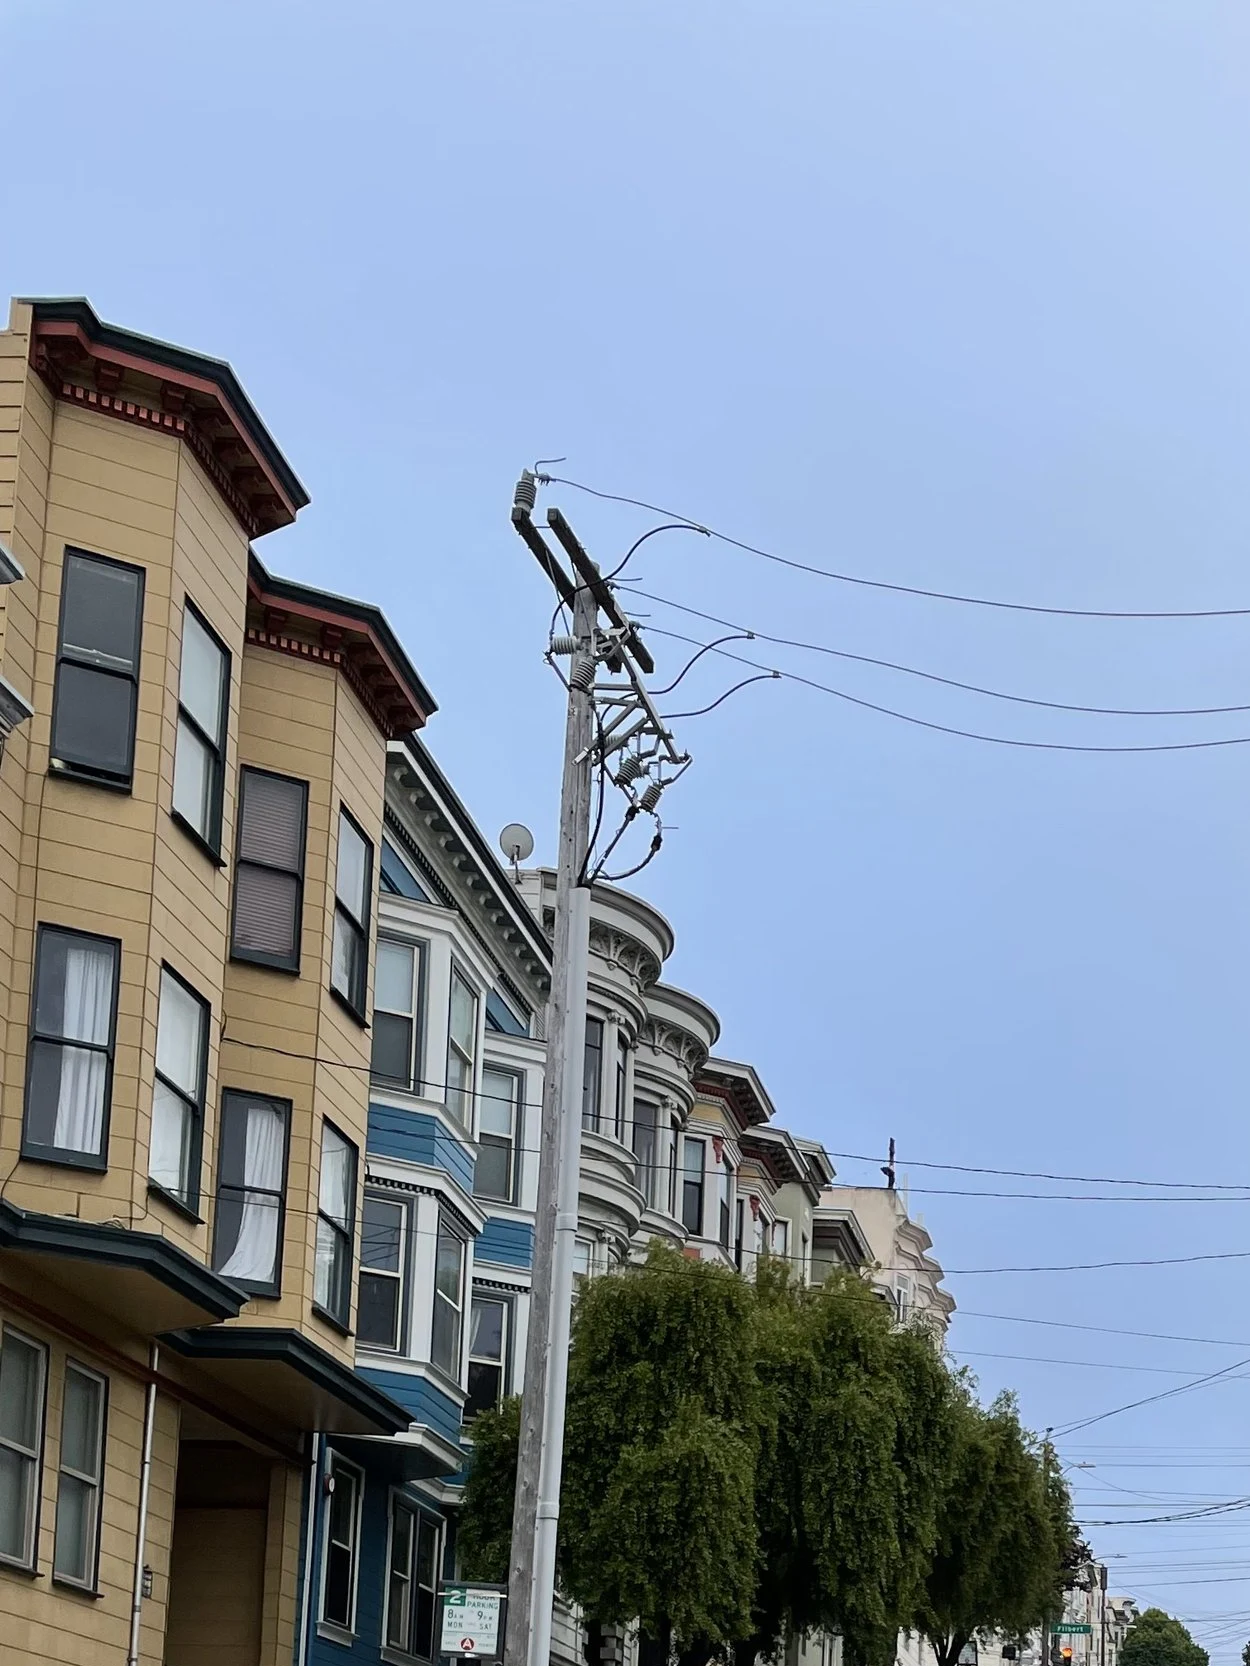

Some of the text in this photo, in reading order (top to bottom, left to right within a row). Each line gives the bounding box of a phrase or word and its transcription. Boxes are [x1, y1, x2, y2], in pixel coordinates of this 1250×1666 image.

[450, 1590, 461, 1604] 2
[466, 1601, 499, 1609] PARKING
[447, 1621, 463, 1629] MON
[462, 1638, 472, 1649] A
